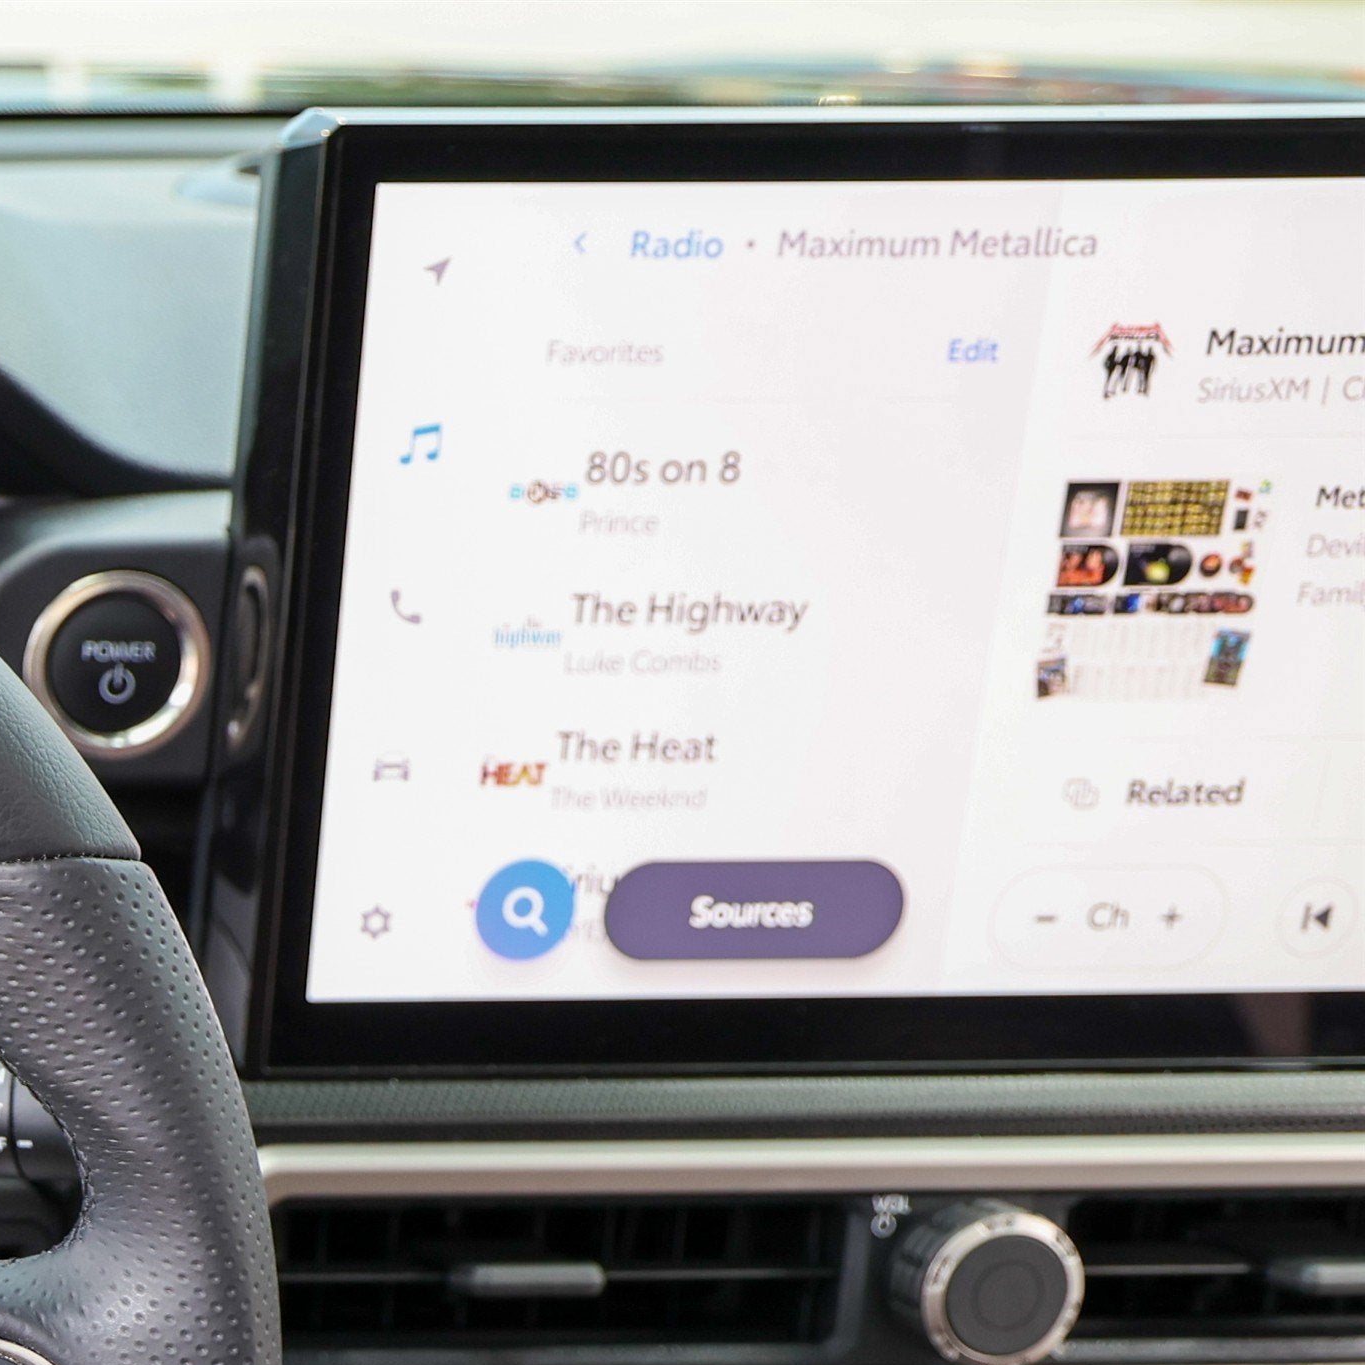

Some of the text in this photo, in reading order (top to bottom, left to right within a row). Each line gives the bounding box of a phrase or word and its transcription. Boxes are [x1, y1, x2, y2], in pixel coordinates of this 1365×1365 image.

[630, 227, 1099, 260] Radio Maximum Metallica
[545, 337, 664, 366] Favorites
[947, 338, 1000, 363] Edit
[1204, 325, 1365, 357] Maximum
[1196, 375, 1311, 404] SiriusXM
[585, 450, 742, 486] 80s on 8
[578, 510, 661, 535] Prince
[572, 591, 810, 635] The Highway
[80, 638, 157, 664] POWER
[564, 650, 722, 676] Luke Combs
[558, 730, 718, 765] The Heat
[479, 762, 548, 787] HEAT
[550, 785, 595, 811] The
[1125, 779, 1247, 805] Related
[688, 895, 814, 929] Sources
[1085, 904, 1130, 930] Ch
